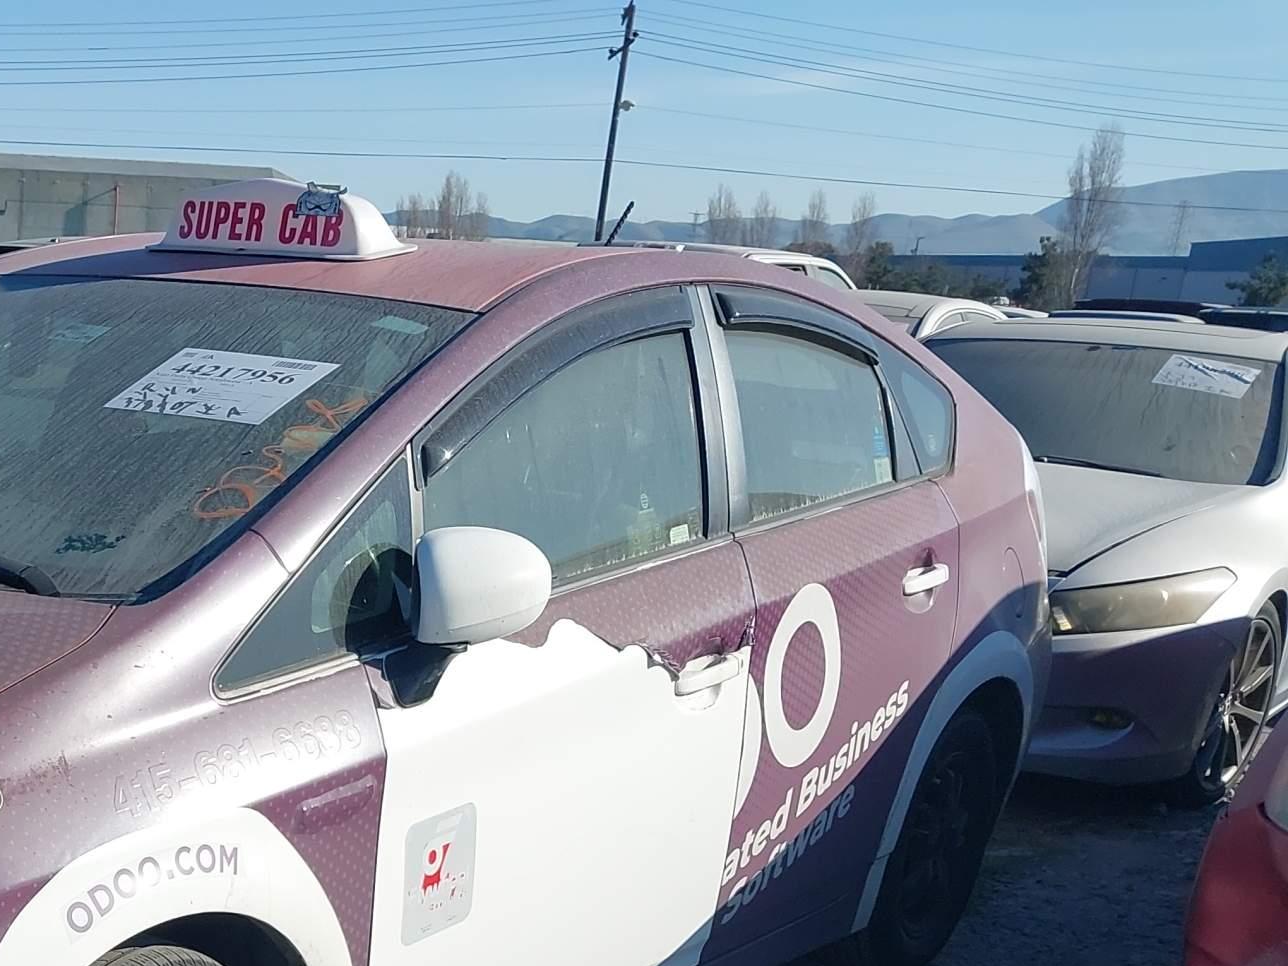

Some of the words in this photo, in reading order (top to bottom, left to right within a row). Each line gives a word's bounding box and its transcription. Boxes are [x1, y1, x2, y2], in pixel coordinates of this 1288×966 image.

[179, 200, 266, 242] SUPER
[278, 203, 344, 247] CAB
[171, 362, 302, 385] 44217956
[721, 787, 794, 886] ated
[795, 680, 909, 818] Business
[66, 844, 238, 933] ODOO.COM
[721, 784, 855, 925] Software
